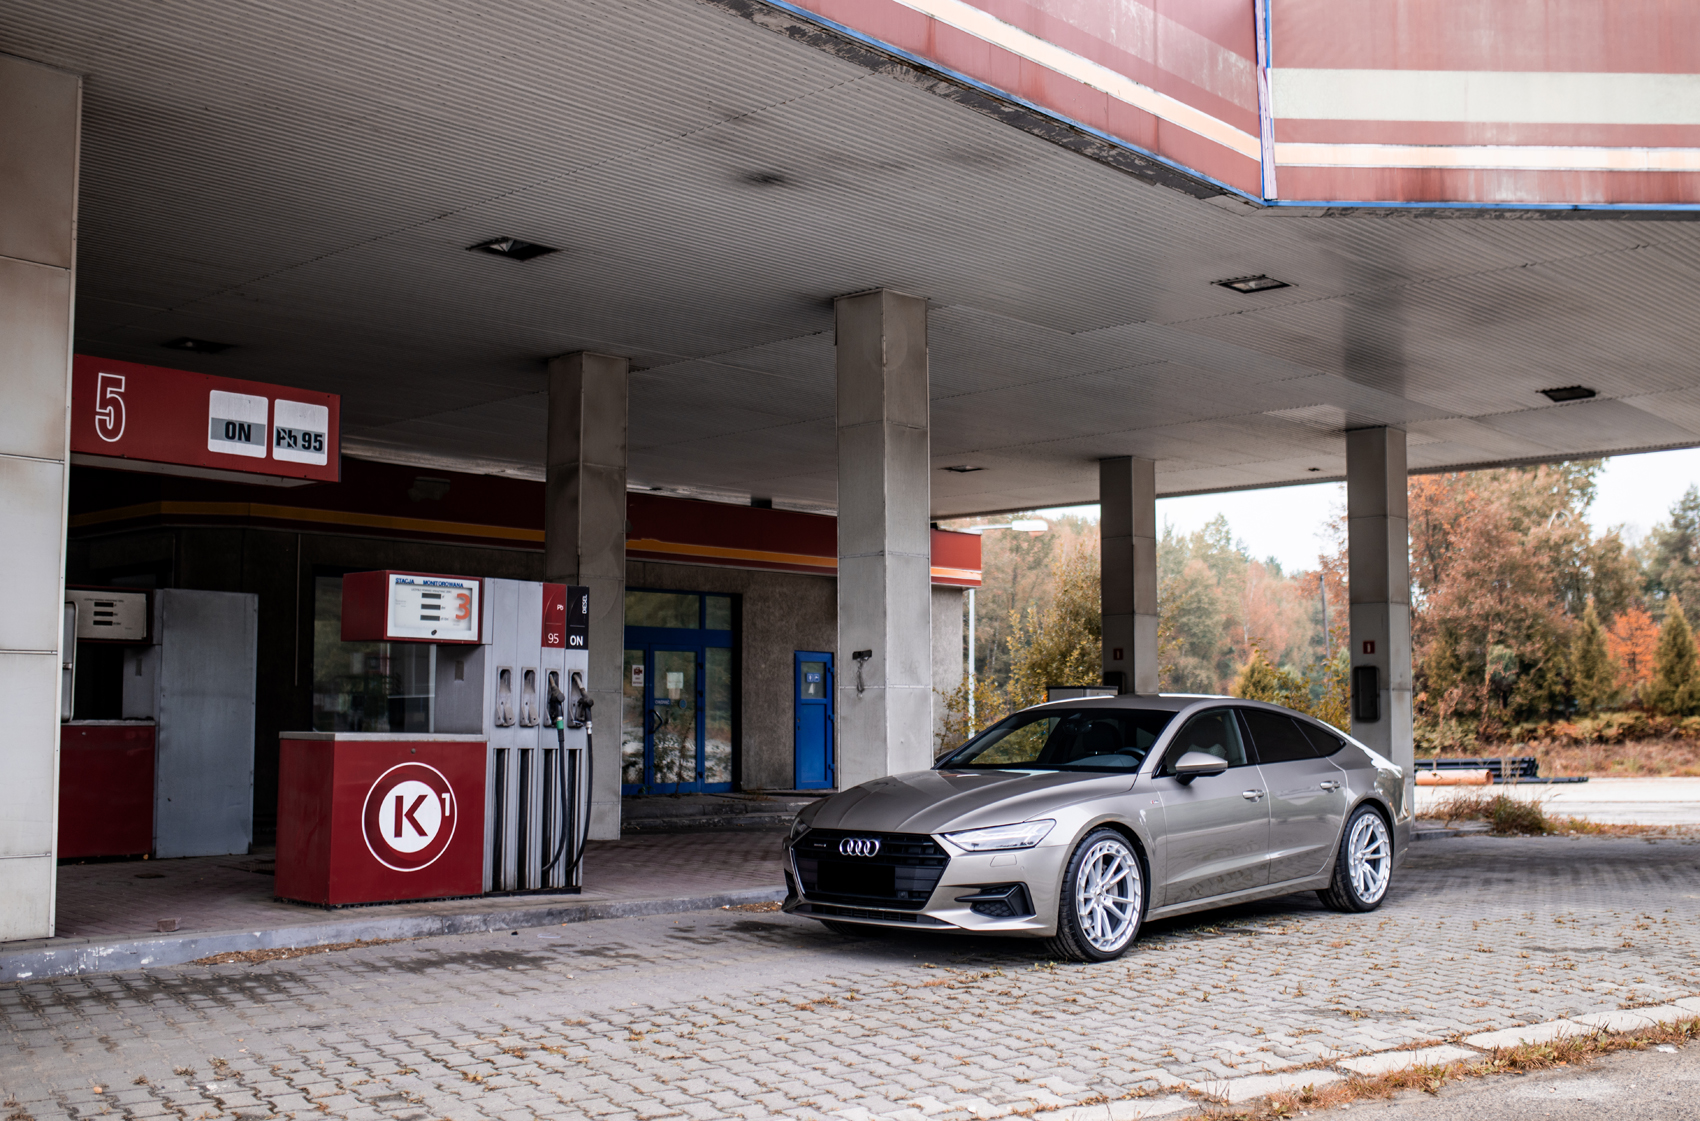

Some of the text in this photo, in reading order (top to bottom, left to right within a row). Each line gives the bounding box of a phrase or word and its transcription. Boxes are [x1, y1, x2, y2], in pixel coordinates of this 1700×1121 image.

[95, 372, 126, 443] 5
[224, 421, 252, 443] ON
[301, 432, 323, 452] 95
[395, 577, 464, 588] STACJA MONITOROWANA
[455, 593, 471, 620] 3
[547, 632, 560, 644] 95
[569, 635, 584, 646] ON
